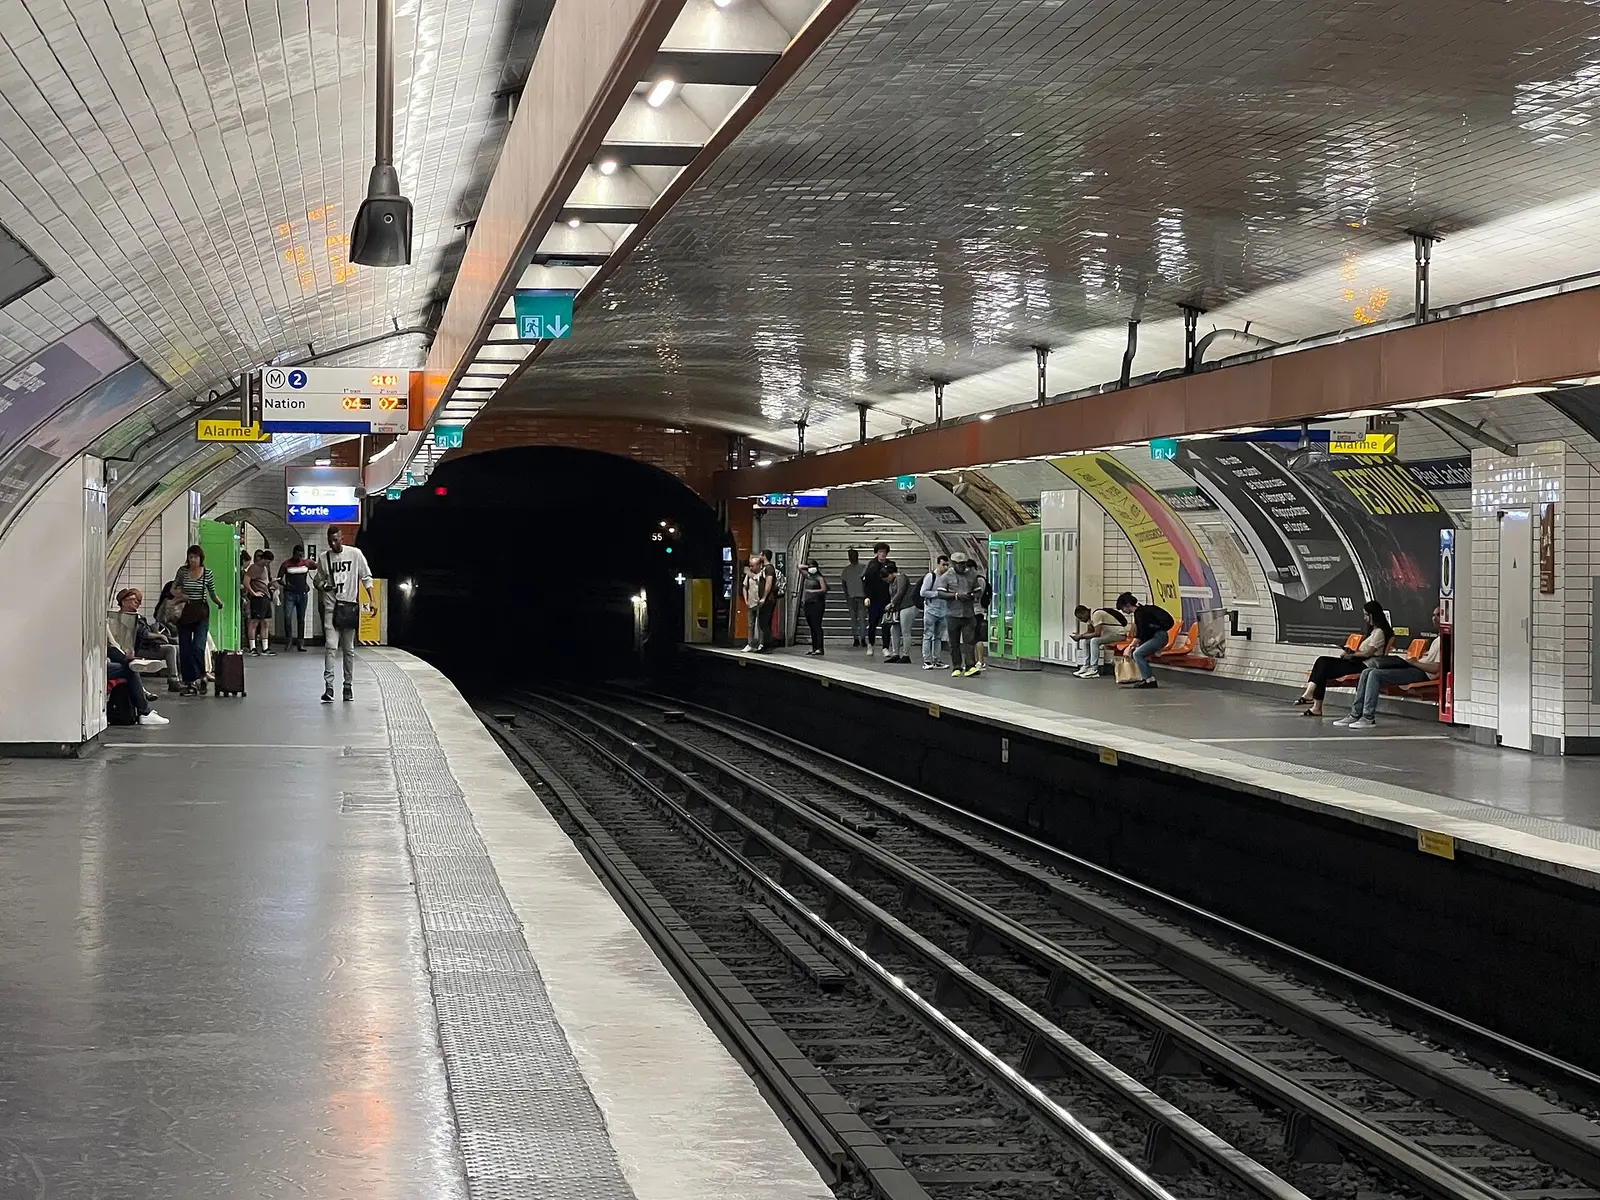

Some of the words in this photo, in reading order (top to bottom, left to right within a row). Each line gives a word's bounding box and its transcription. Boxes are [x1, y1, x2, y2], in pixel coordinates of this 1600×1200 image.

[265, 398, 305, 409] Nation
[343, 397, 361, 409] 04
[379, 397, 398, 410] 07
[203, 425, 251, 436] Alarme
[1409, 466, 1444, 485] Père
[1332, 464, 1440, 515] FESTIVALS
[300, 506, 329, 516] Sortie
[652, 533, 662, 541] 55
[332, 560, 352, 573] JUST
[1340, 597, 1354, 611] VISA
